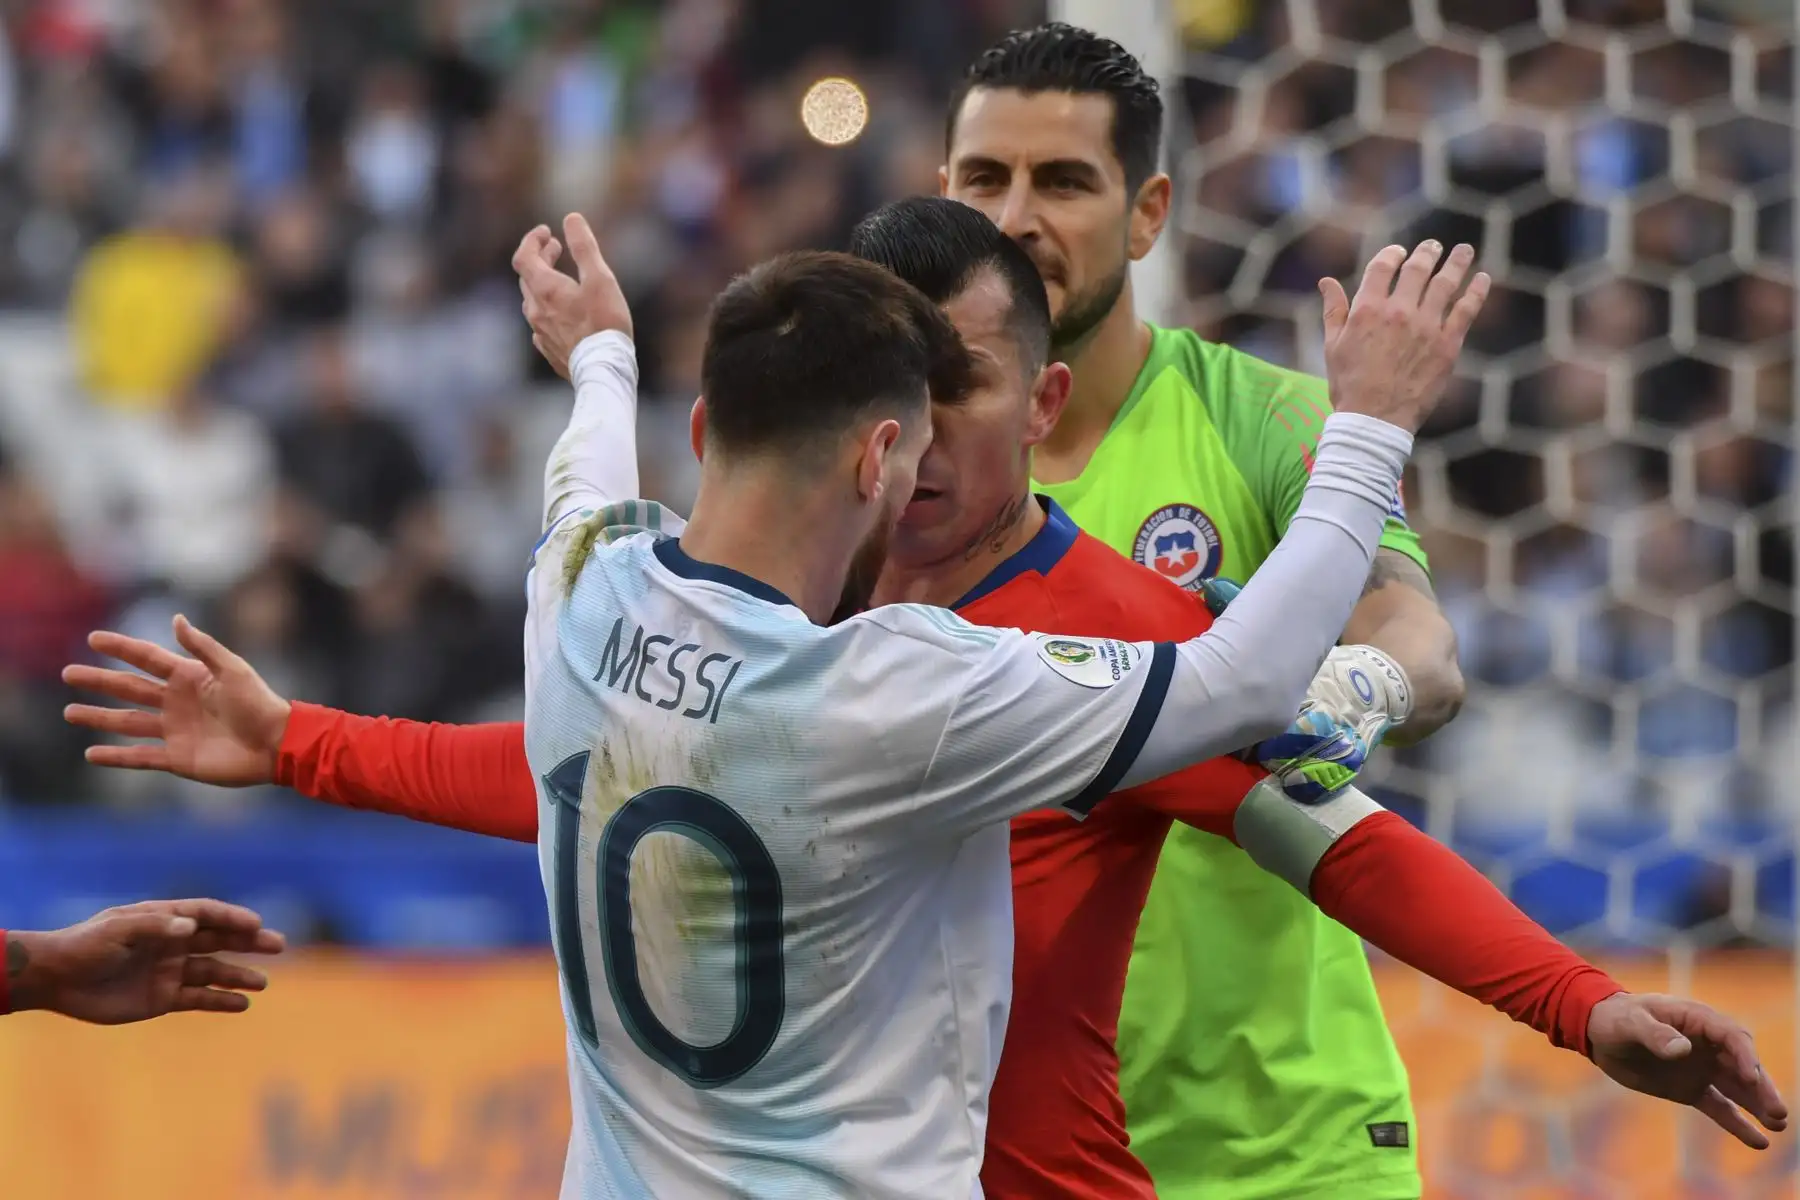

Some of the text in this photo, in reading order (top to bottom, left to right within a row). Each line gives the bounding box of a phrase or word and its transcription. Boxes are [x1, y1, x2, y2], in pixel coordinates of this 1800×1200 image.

[1178, 506, 1192, 518] DE
[1193, 512, 1219, 549] FUTBOL
[592, 616, 744, 724] MESSI
[1110, 658, 1121, 681] COPA
[541, 749, 786, 1090] 10
